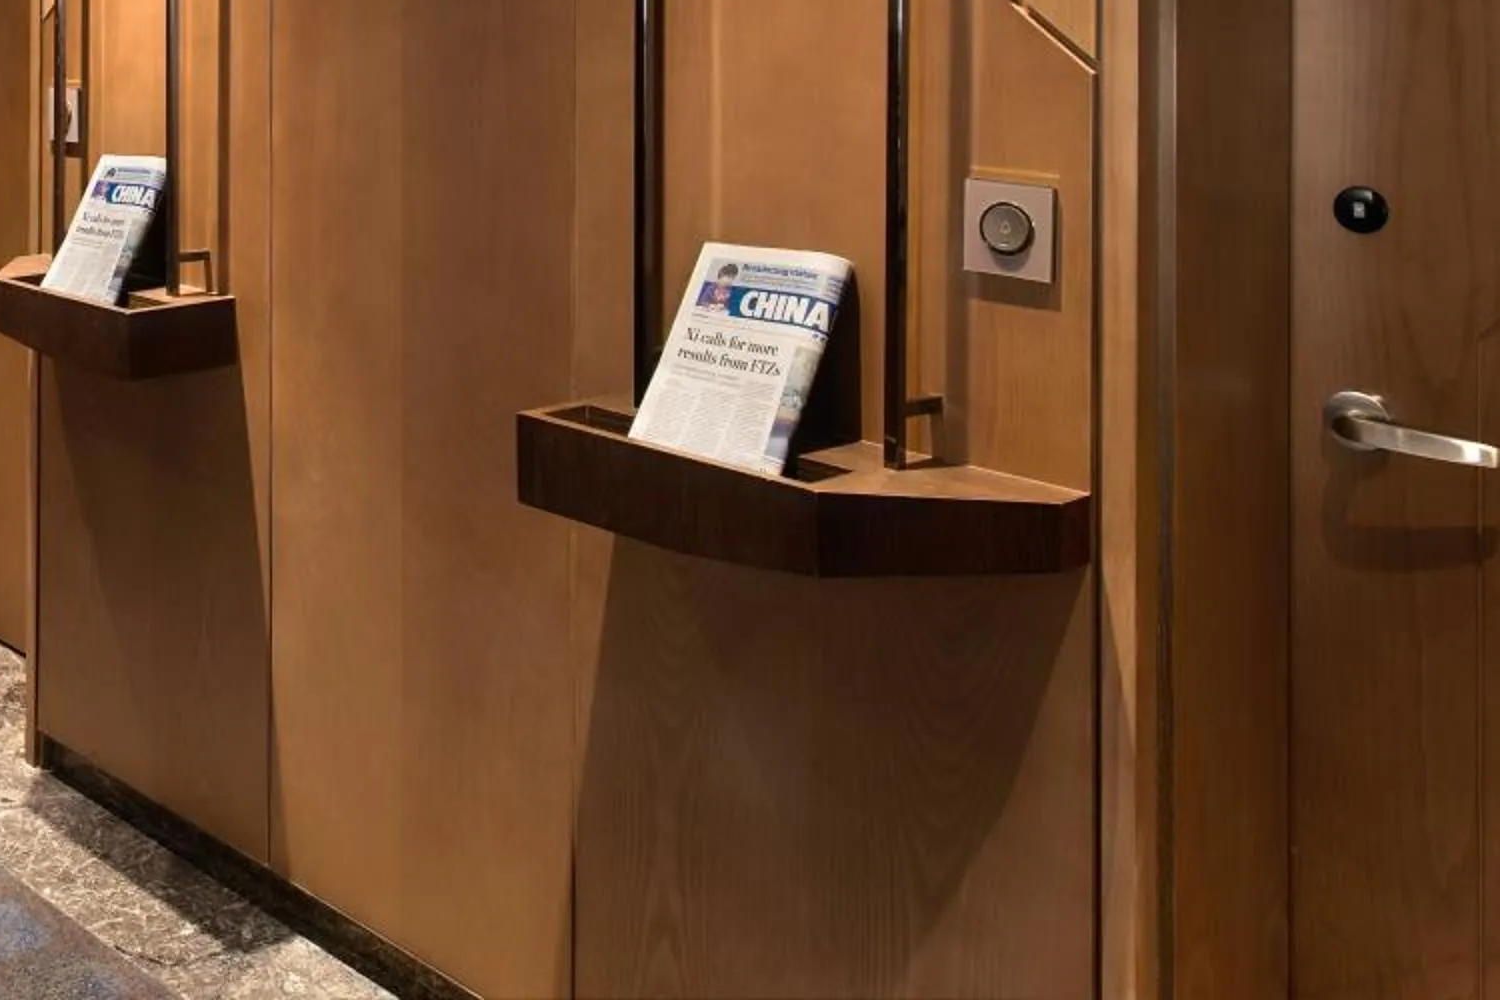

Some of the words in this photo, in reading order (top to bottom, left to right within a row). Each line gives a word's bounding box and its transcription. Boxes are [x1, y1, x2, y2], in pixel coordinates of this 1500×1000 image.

[738, 290, 830, 332] CHINA
[701, 332, 727, 346] calls
[728, 335, 746, 350] for
[748, 343, 779, 356] more
[677, 347, 717, 364] results
[719, 353, 749, 371] from
